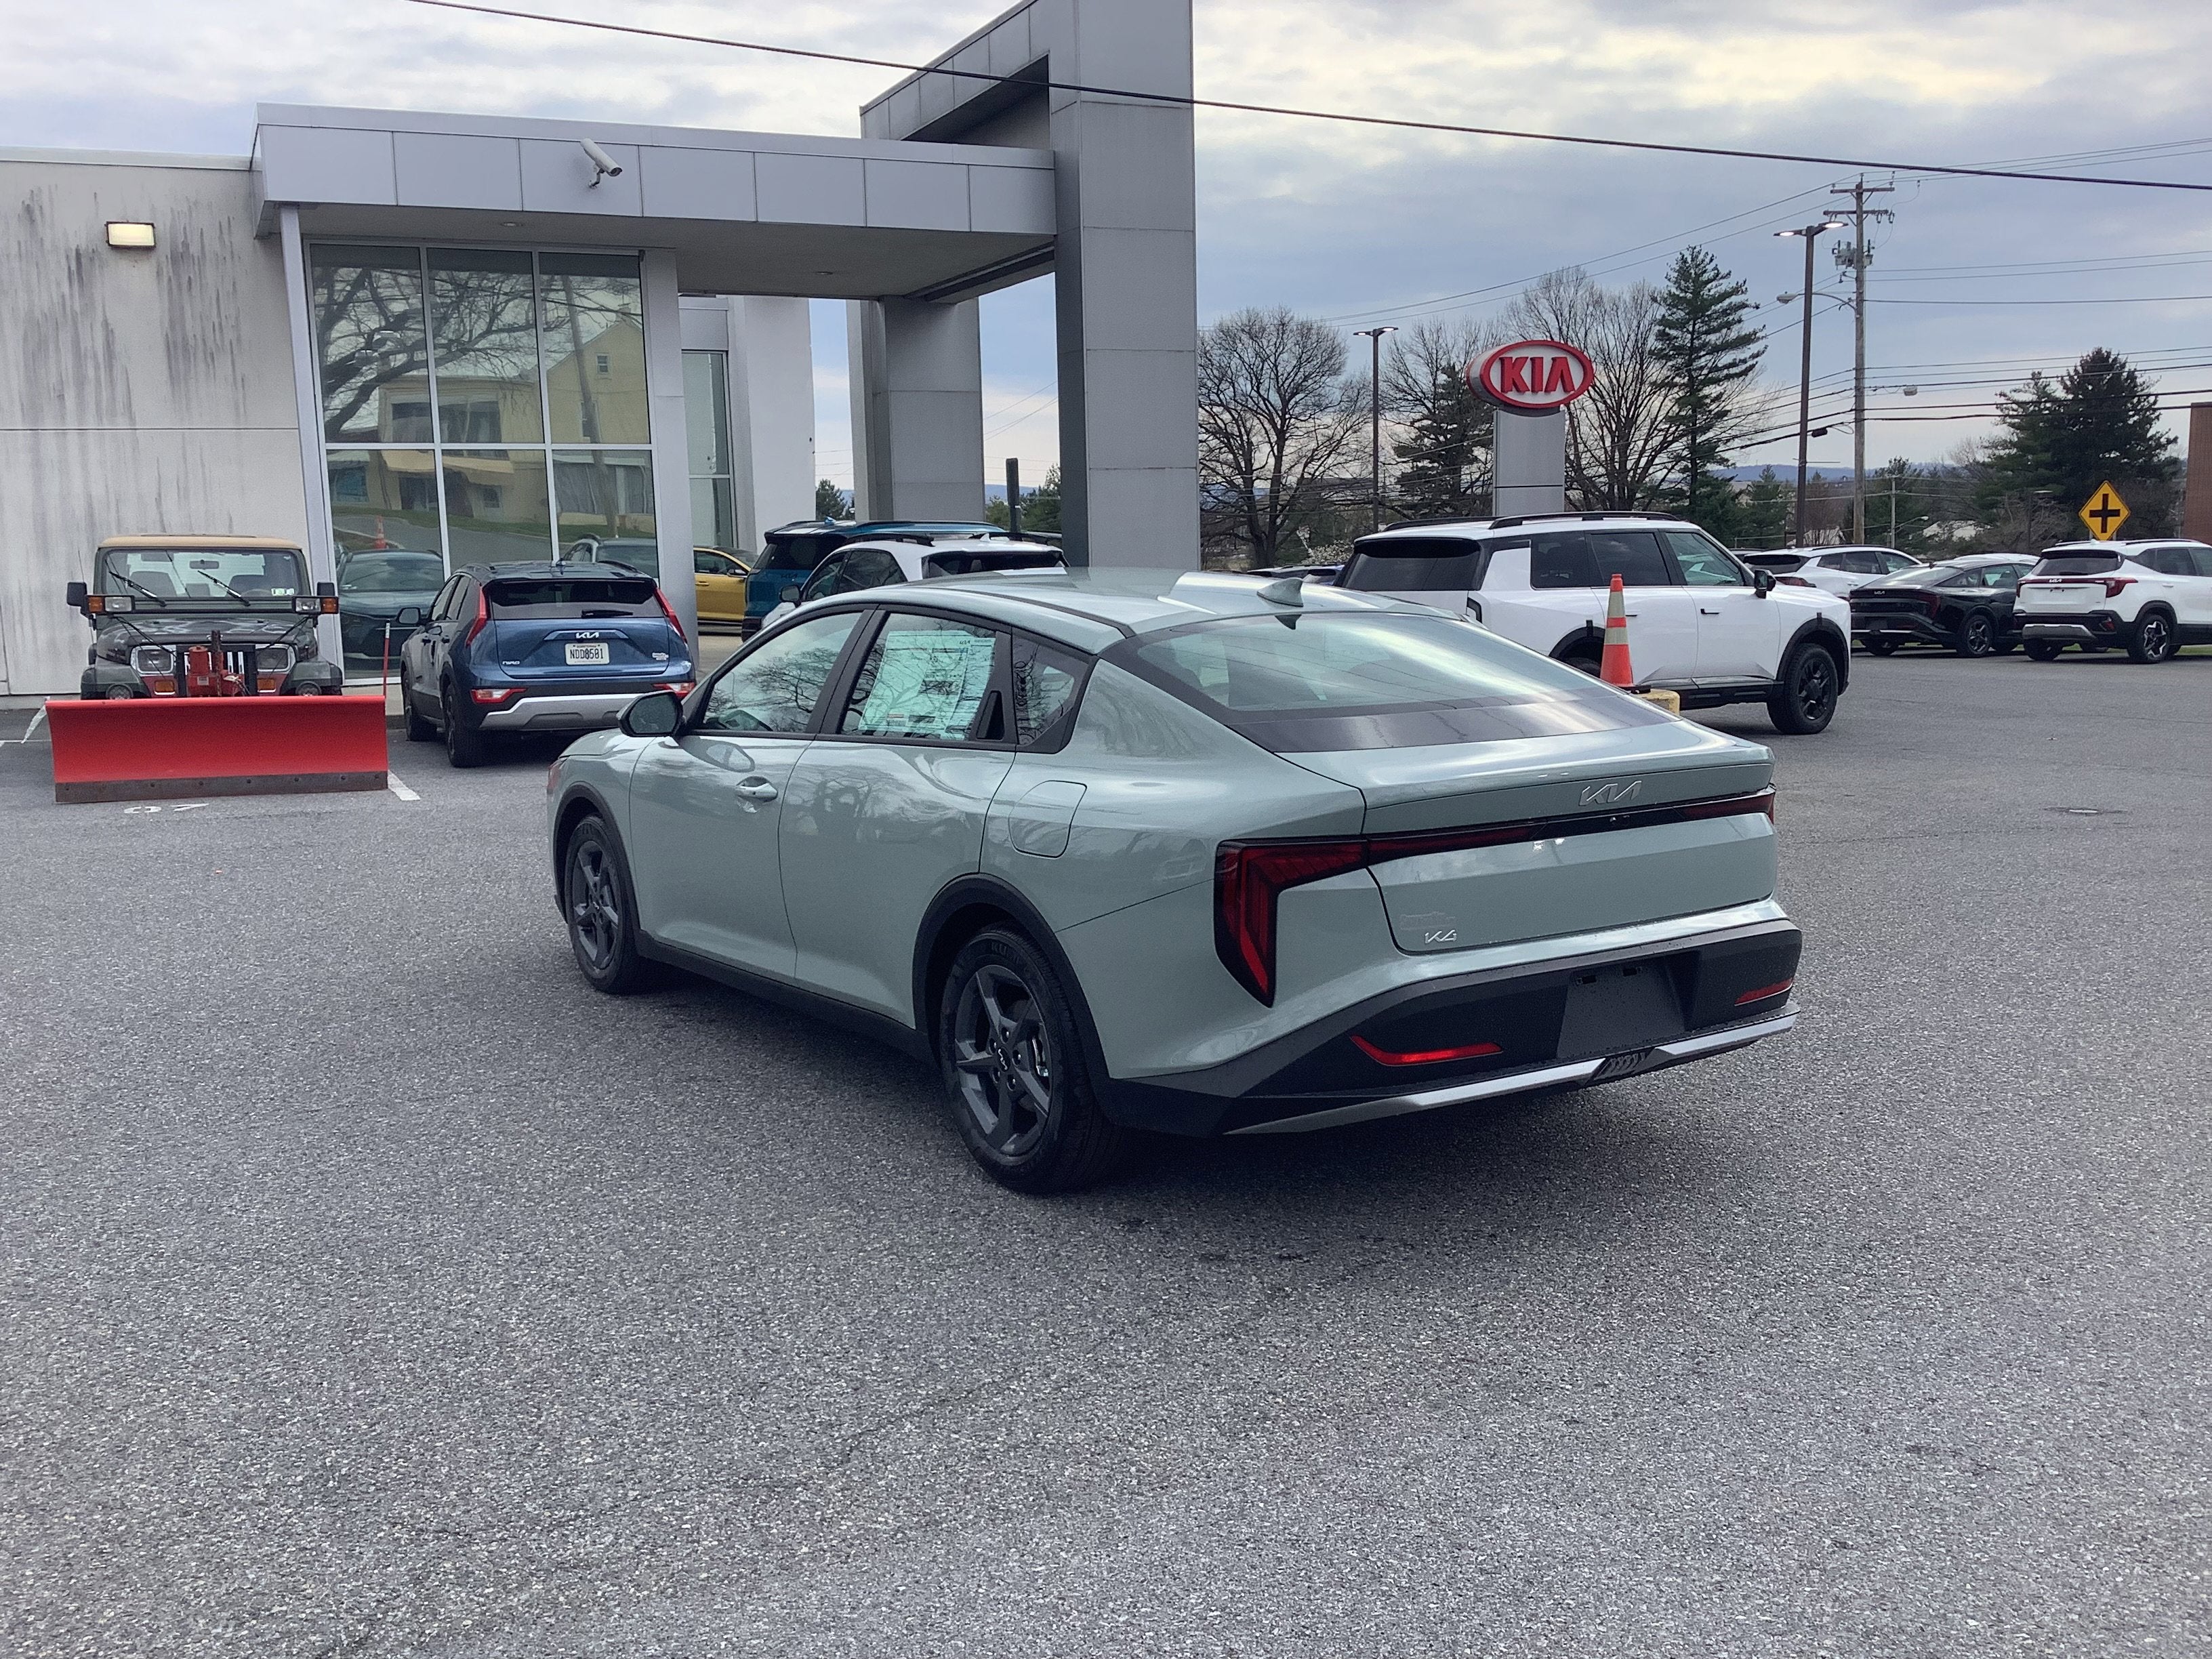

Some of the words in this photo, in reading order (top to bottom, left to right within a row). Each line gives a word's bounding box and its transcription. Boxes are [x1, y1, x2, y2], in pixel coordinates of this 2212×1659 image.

[1499, 356, 1576, 393] KIA
[1578, 780, 1642, 806] KIA
[1425, 929, 1457, 944] K4
